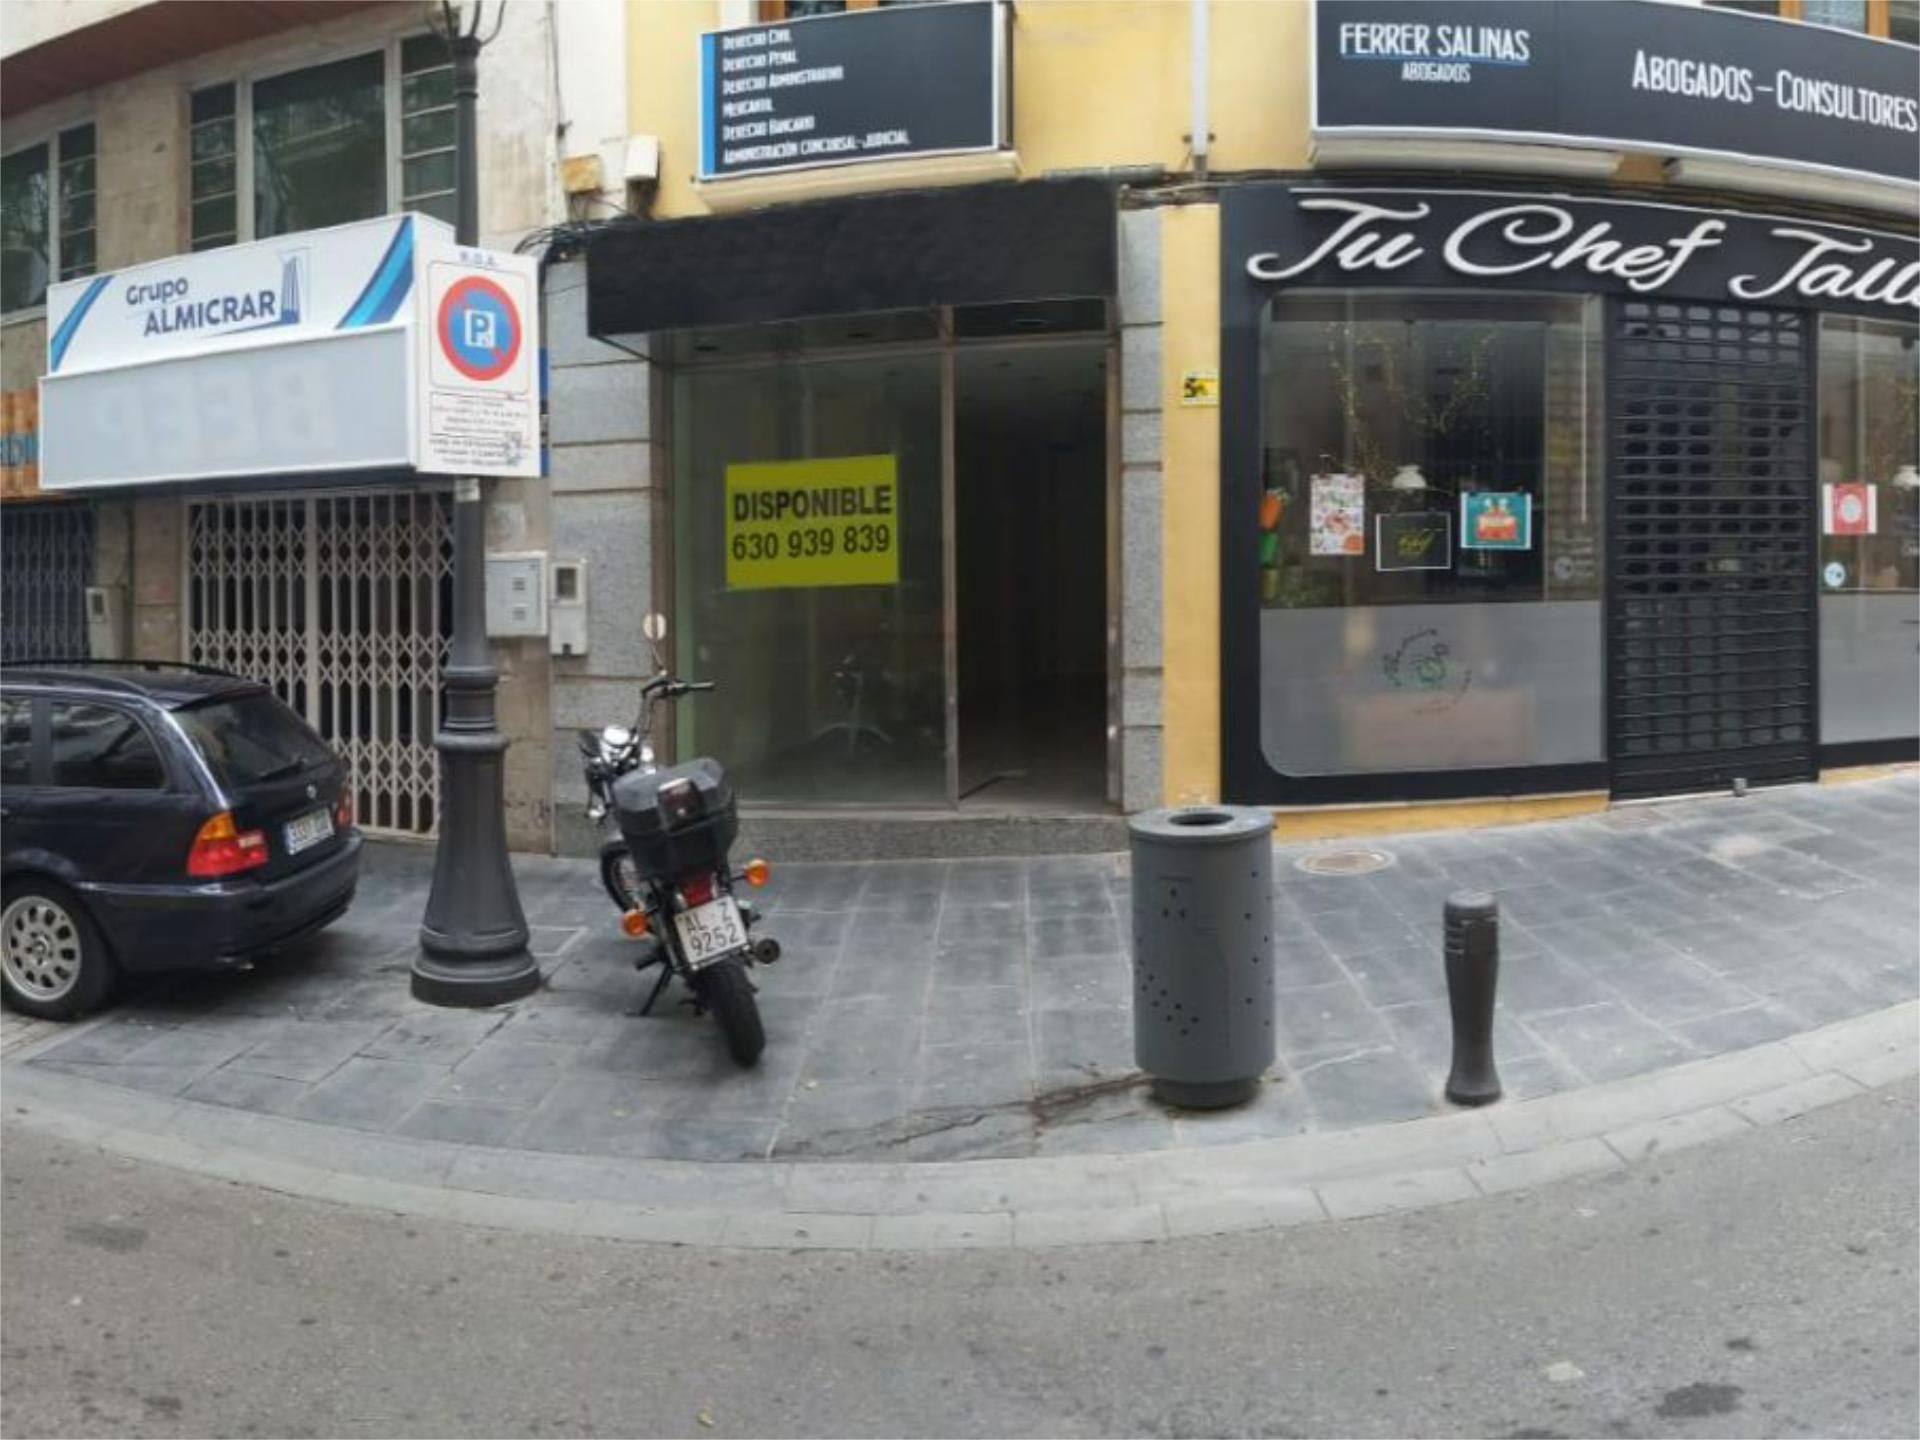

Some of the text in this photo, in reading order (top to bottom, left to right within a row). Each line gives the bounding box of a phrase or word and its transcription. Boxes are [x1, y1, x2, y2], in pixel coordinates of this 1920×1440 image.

[1339, 22, 1530, 62] FERRER SALINAS
[1401, 62, 1472, 83] ABOGADOS
[1632, 50, 1753, 104] ABOGADOS
[1776, 70, 1919, 132] CONSULTORES
[1246, 199, 1920, 308] Tu Chef Tall
[143, 290, 276, 338] ALMICRAR
[733, 485, 892, 522] DISPONIBLE
[732, 523, 891, 560] 630 939 839
[691, 923, 738, 956] 9252
